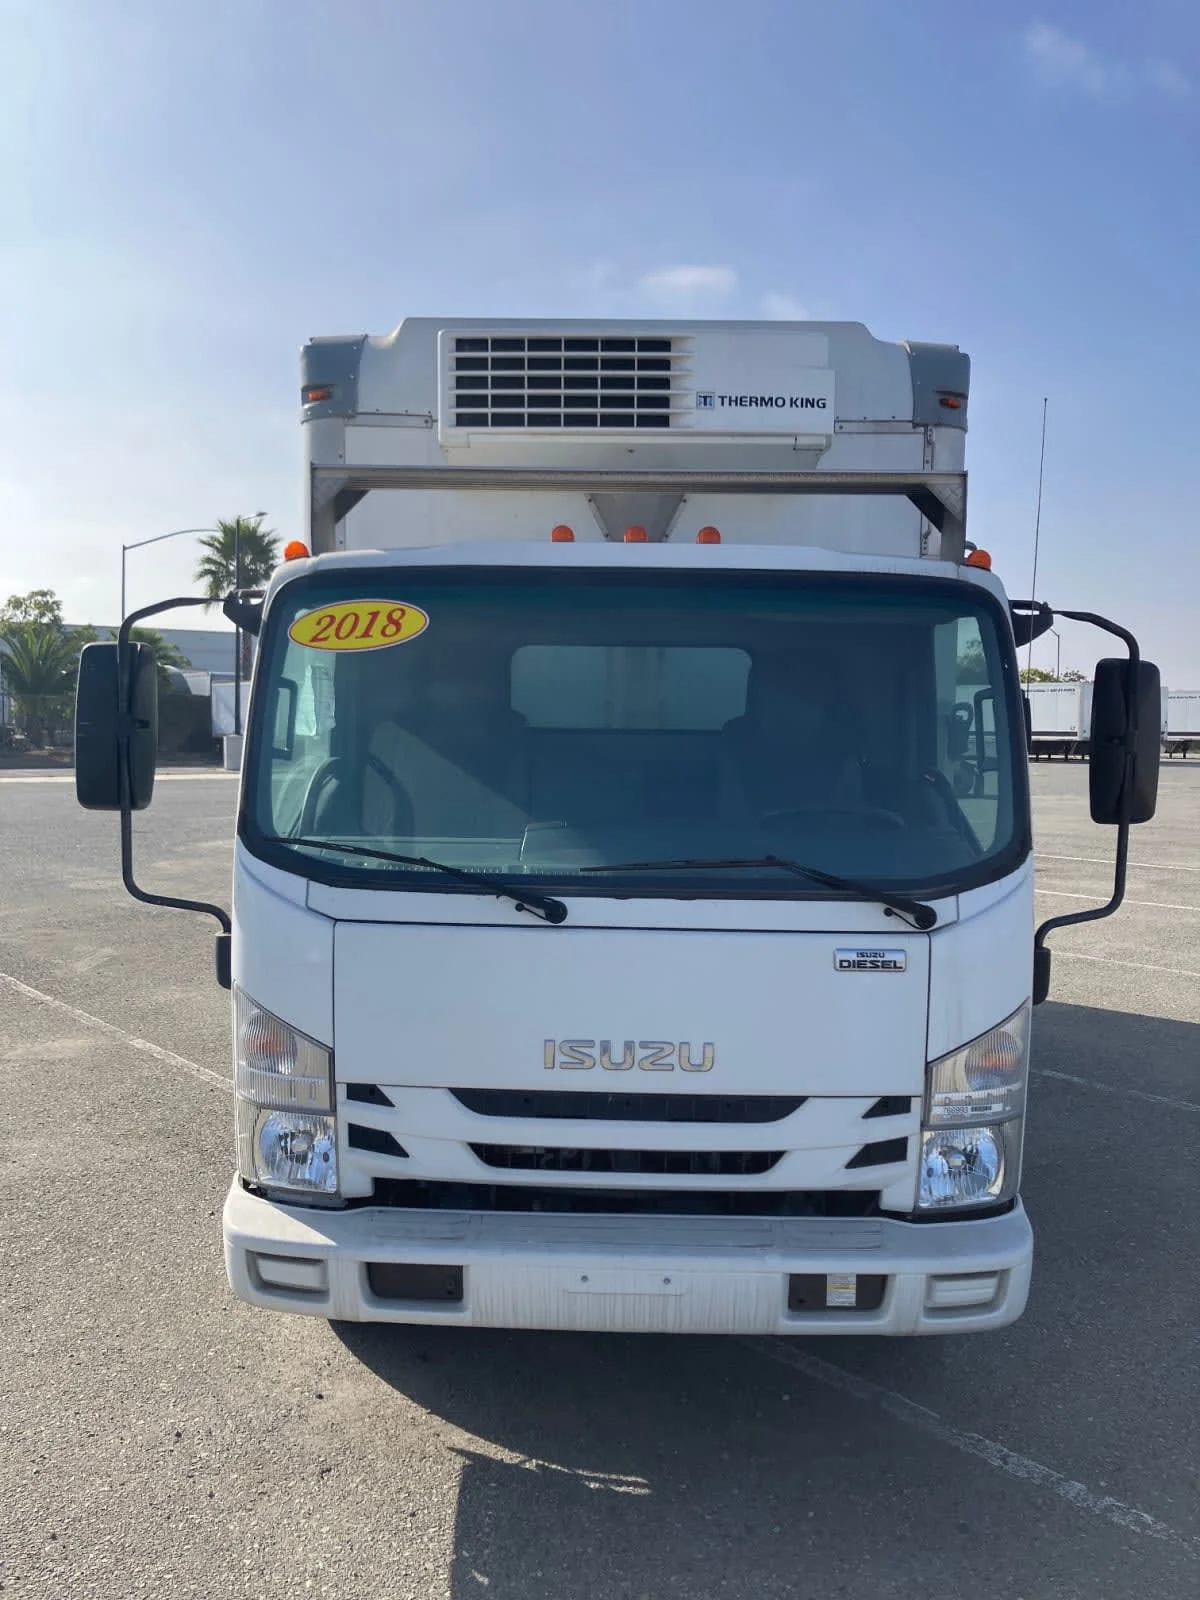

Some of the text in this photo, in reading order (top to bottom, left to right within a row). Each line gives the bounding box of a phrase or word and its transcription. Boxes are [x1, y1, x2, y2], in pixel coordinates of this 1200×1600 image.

[718, 395, 786, 408] THERMO
[789, 397, 827, 409] KING
[309, 607, 407, 643] 2018
[856, 951, 885, 959] ISUZU
[838, 959, 904, 970] DIESEL
[543, 1039, 715, 1073] ISUZU
